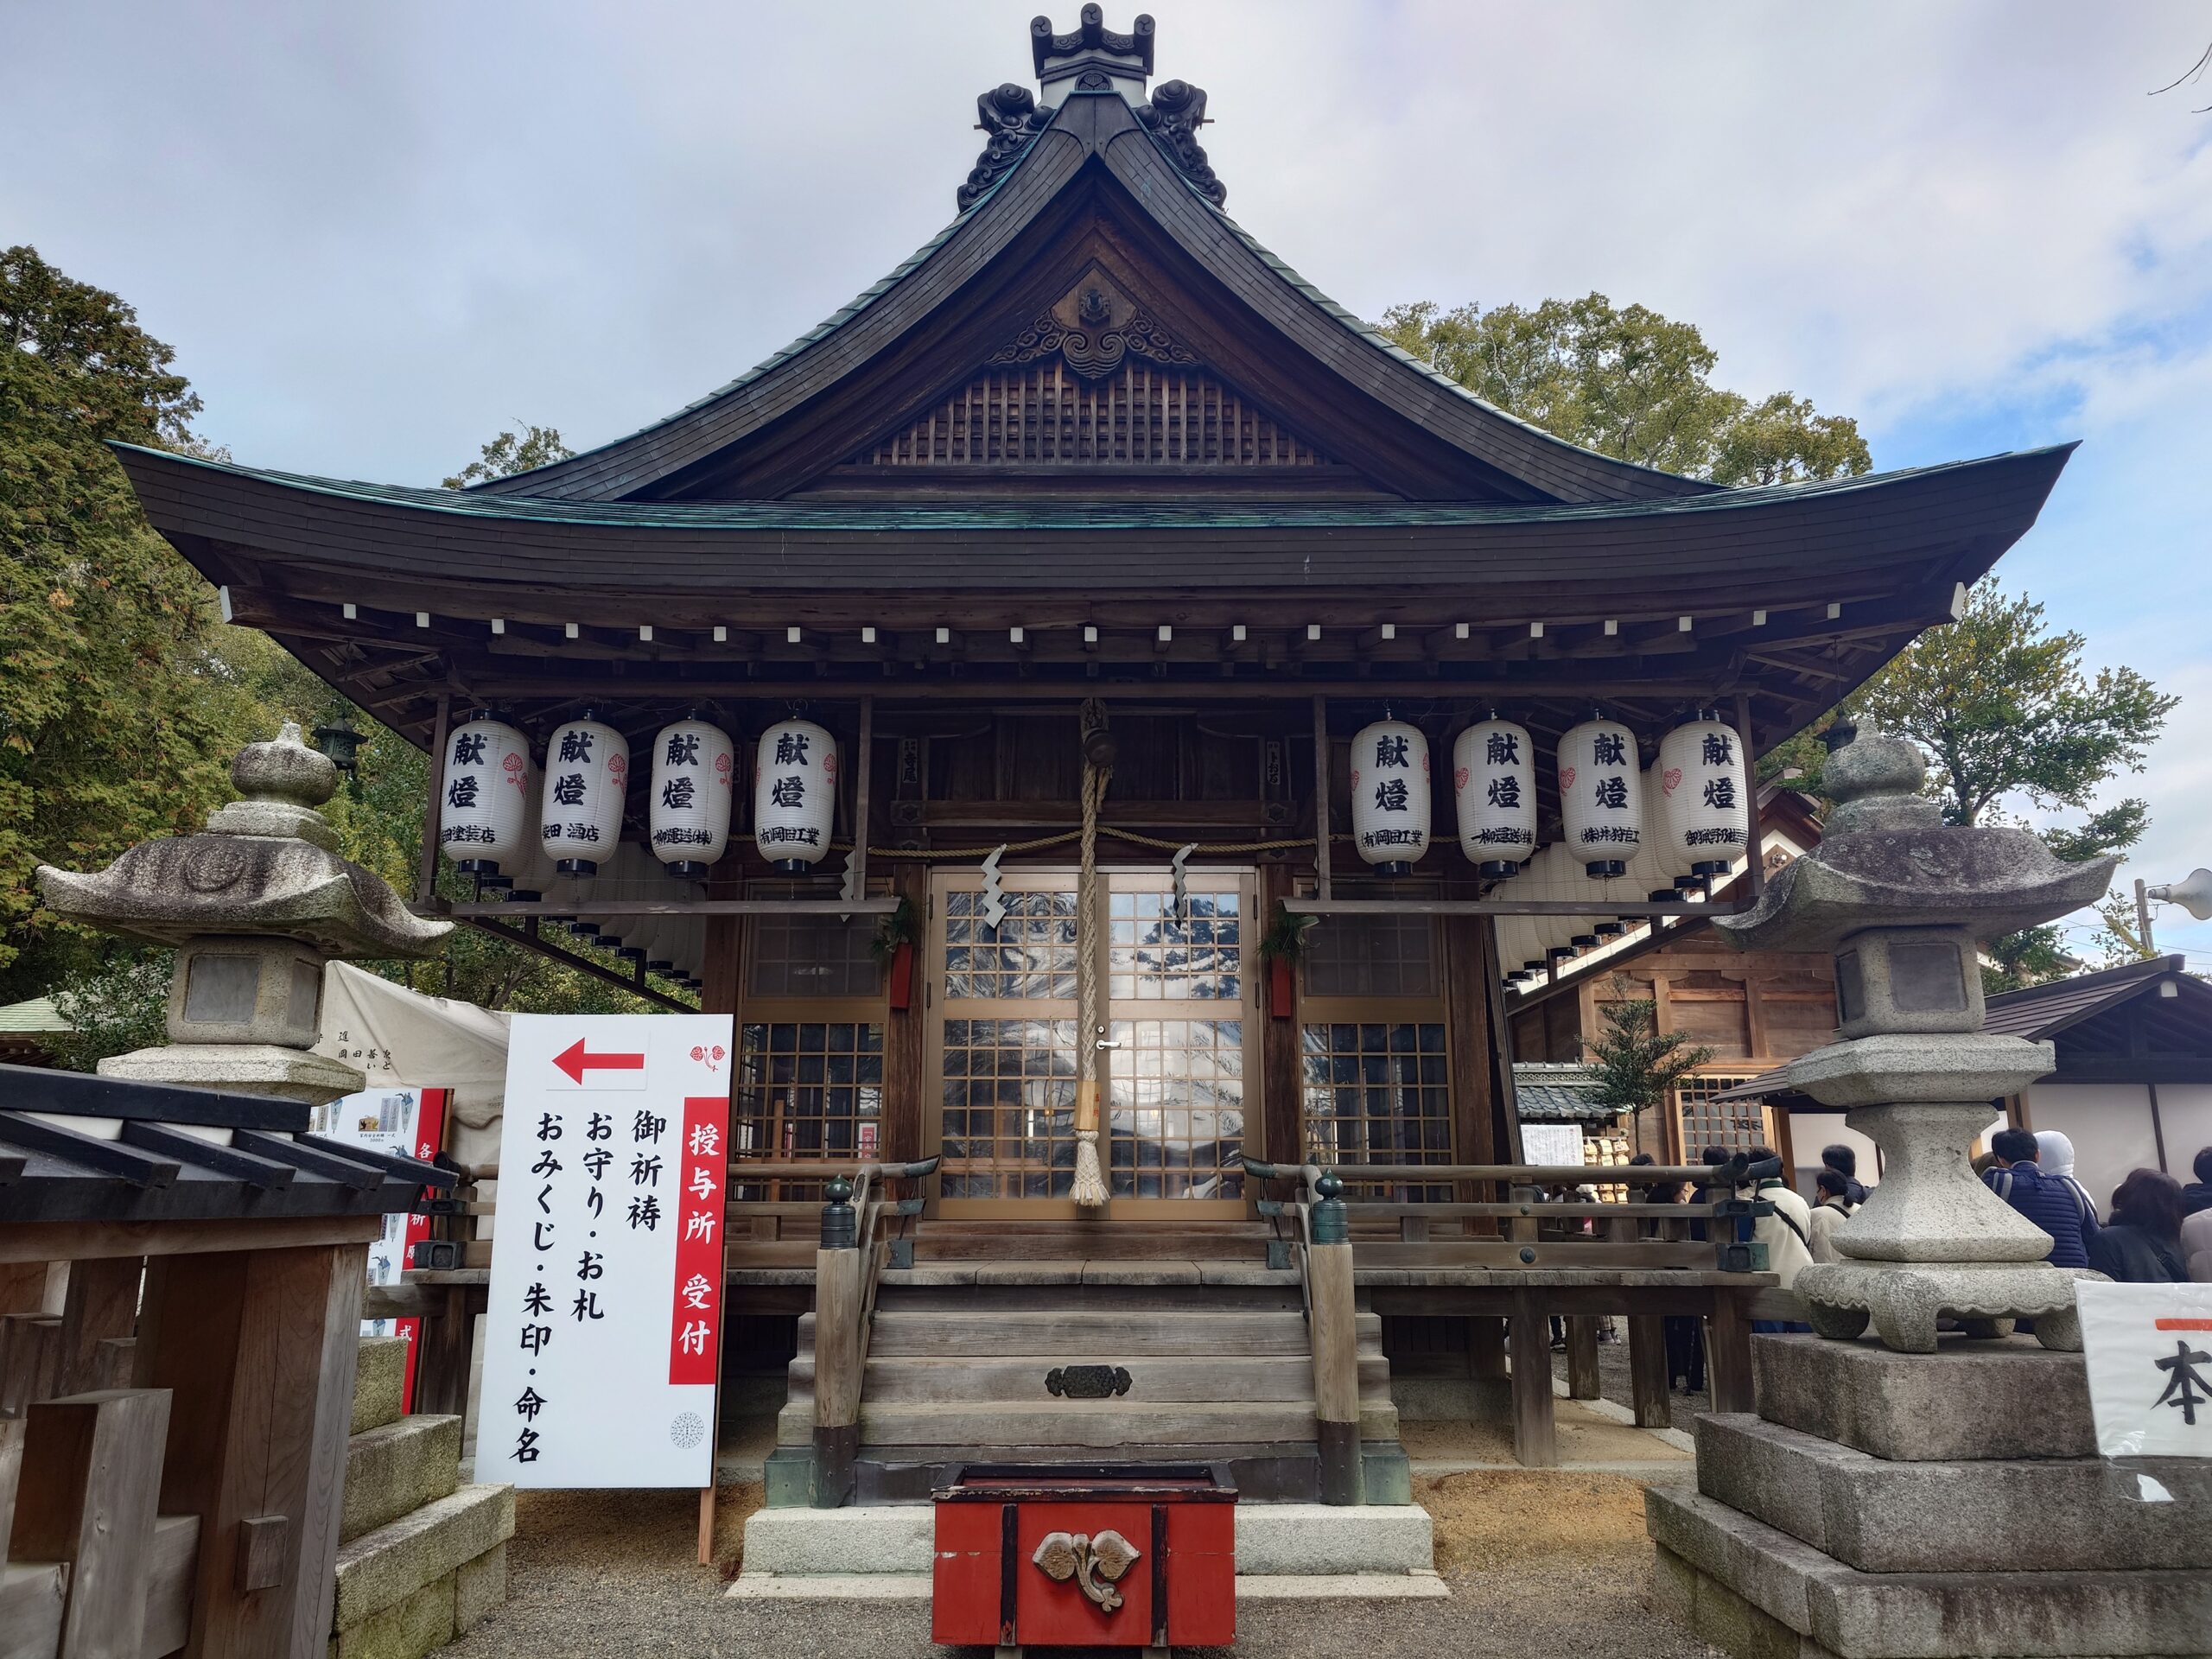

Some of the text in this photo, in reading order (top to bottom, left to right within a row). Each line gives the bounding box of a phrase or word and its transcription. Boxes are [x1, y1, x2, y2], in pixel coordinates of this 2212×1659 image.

[448, 733, 487, 808] 献燈
[553, 730, 594, 805] 献燈
[662, 733, 700, 809] 献燈
[771, 733, 810, 808] 献燈
[1376, 734, 1408, 811] 献燈
[1486, 733, 1521, 809] 献燈
[1593, 733, 1628, 810] 献燈
[1702, 733, 1736, 810] 献燈
[626, 1109, 667, 1231] 御祈祷
[570, 1112, 614, 1322] お守り・お札
[677, 1122, 721, 1356] 授与所 受付
[509, 1112, 563, 1463] おみくじ・朱印・命名
[2150, 1340, 2212, 1425] 本
